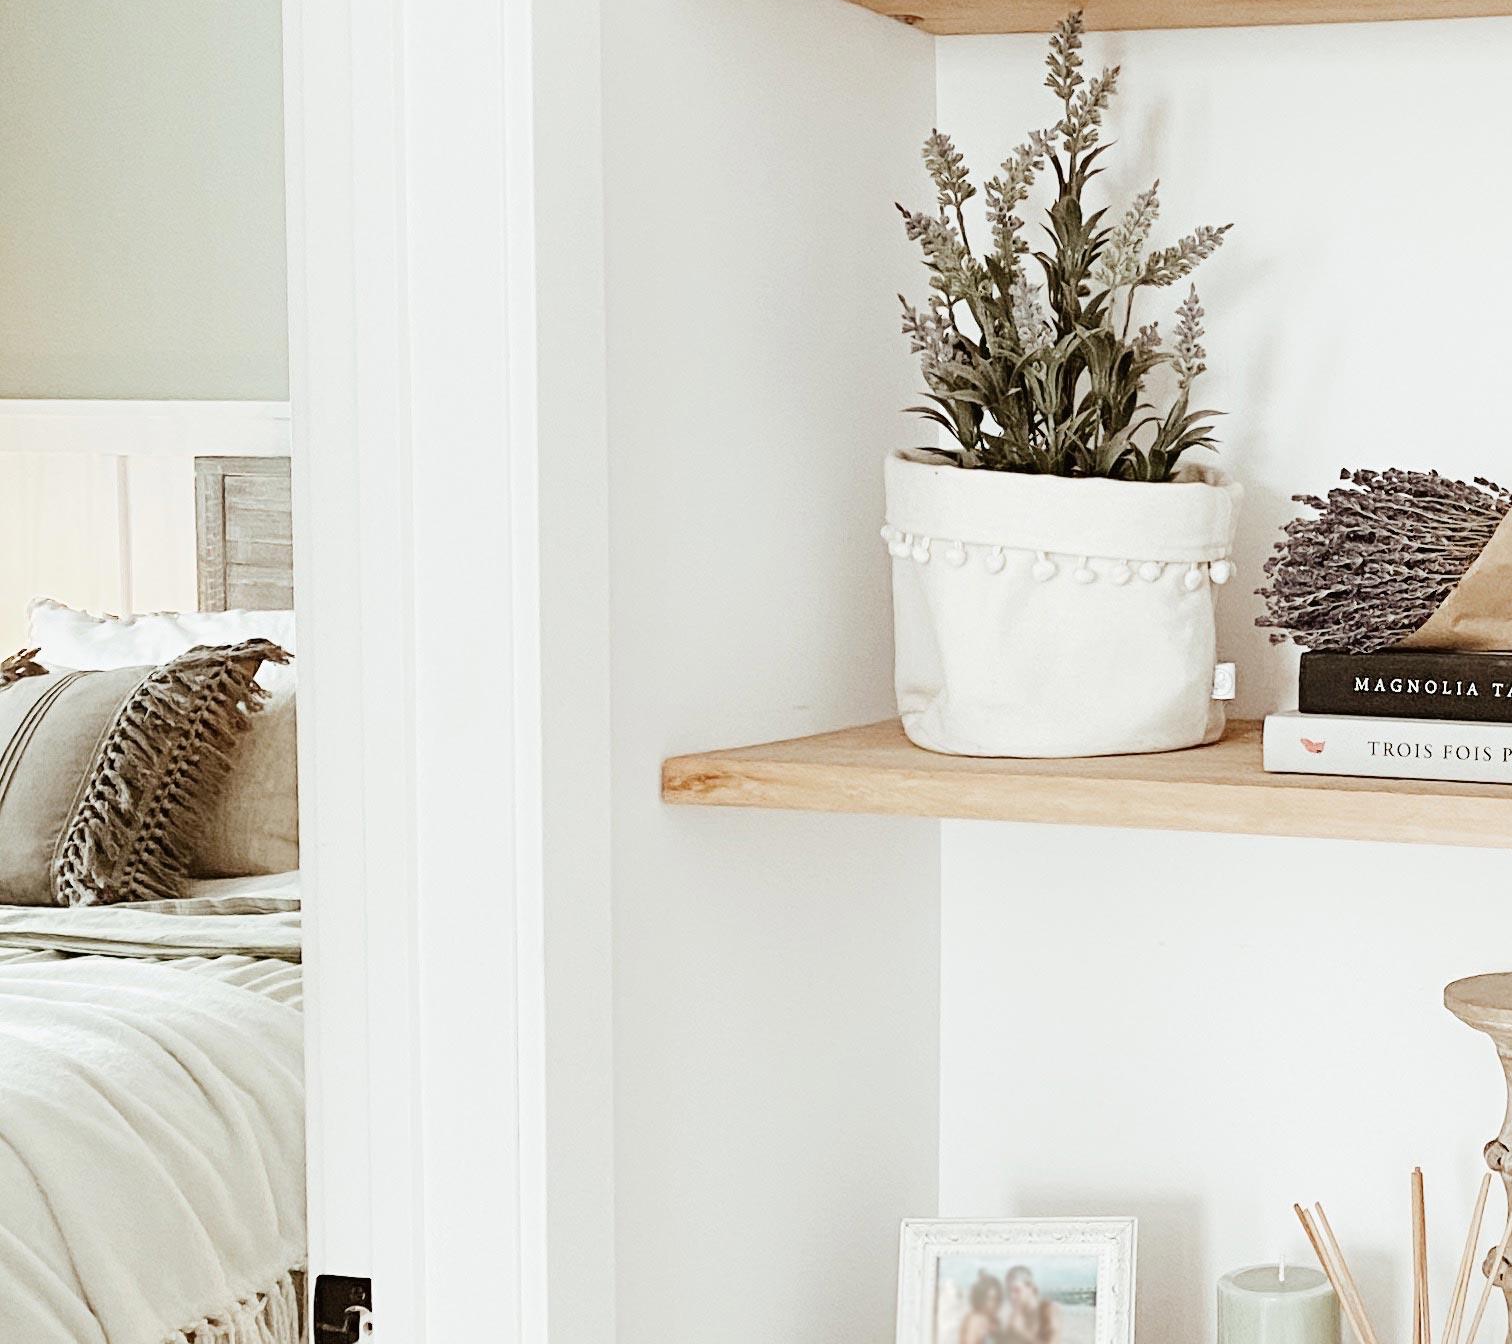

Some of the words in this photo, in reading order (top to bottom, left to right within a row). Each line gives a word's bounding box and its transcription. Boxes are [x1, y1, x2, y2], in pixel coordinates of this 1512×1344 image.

[1354, 677, 1479, 697] MAGNOLIA
[1368, 741, 1433, 759] TROIS
[1443, 744, 1492, 762] FOIS
